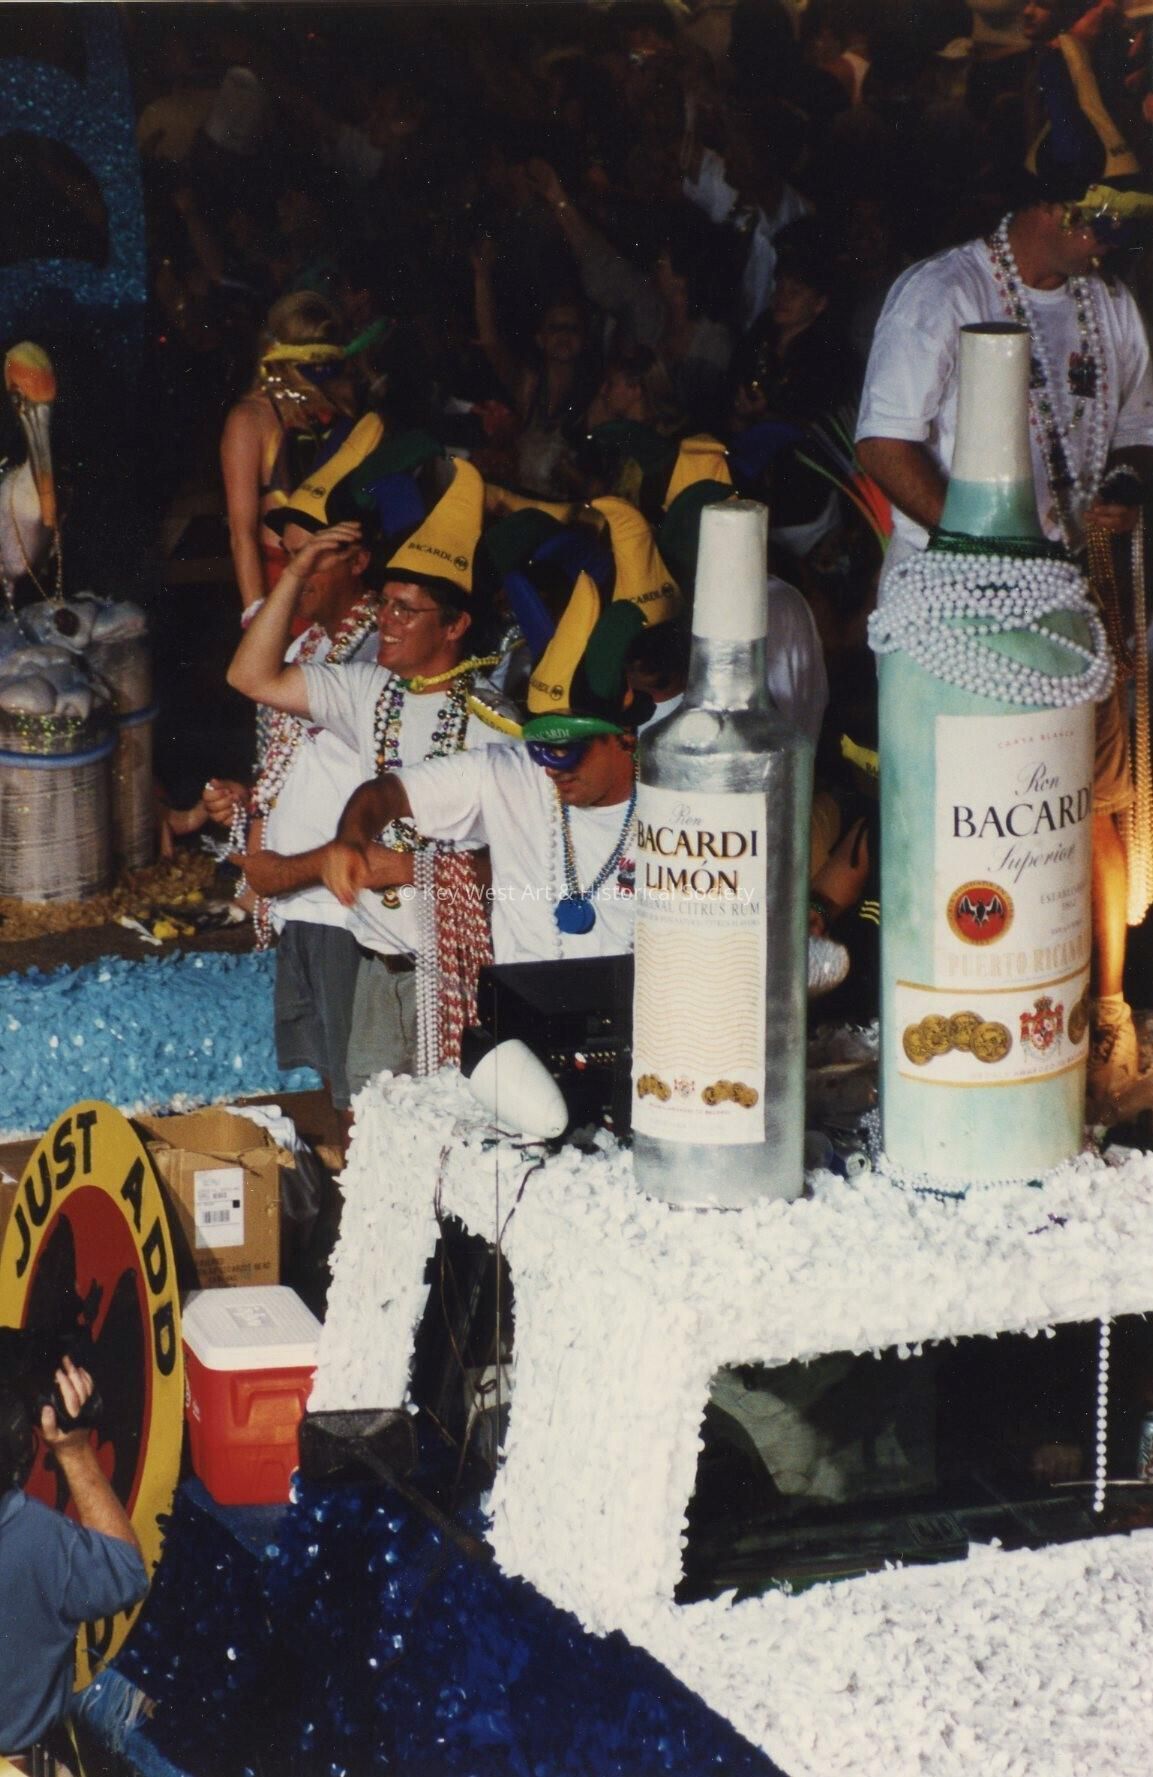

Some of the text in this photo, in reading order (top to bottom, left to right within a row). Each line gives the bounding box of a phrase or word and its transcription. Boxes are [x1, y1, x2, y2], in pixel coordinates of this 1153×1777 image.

[1014, 762, 1059, 796] Ron
[637, 819, 758, 858] BACARDI
[645, 860, 738, 896] LIMÓN
[731, 902, 760, 917] RUM
[15, 1110, 176, 1377] JUST ADD
